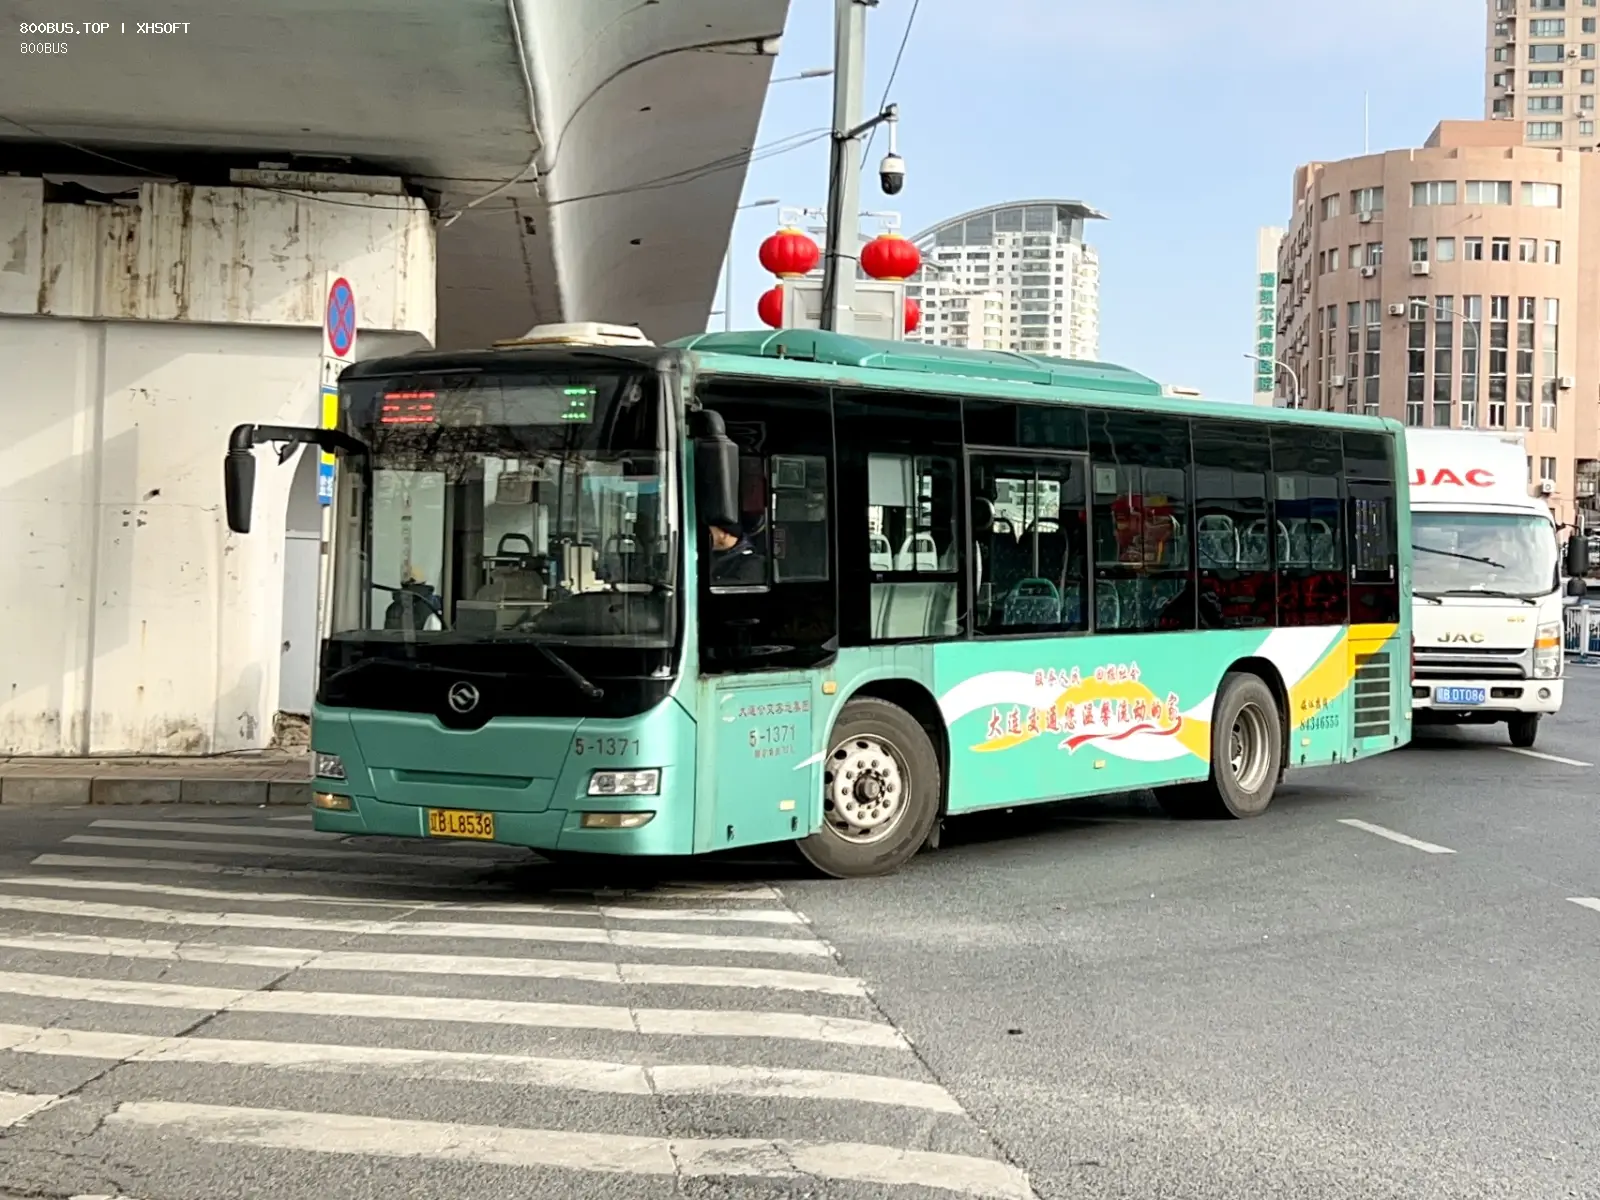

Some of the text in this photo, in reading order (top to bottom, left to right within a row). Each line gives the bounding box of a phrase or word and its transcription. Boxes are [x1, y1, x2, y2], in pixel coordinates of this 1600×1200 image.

[1408, 468, 1496, 488] JAC
[1437, 631, 1485, 643] JAC
[749, 724, 796, 748] 5-1371
[575, 737, 640, 757] 5-1371
